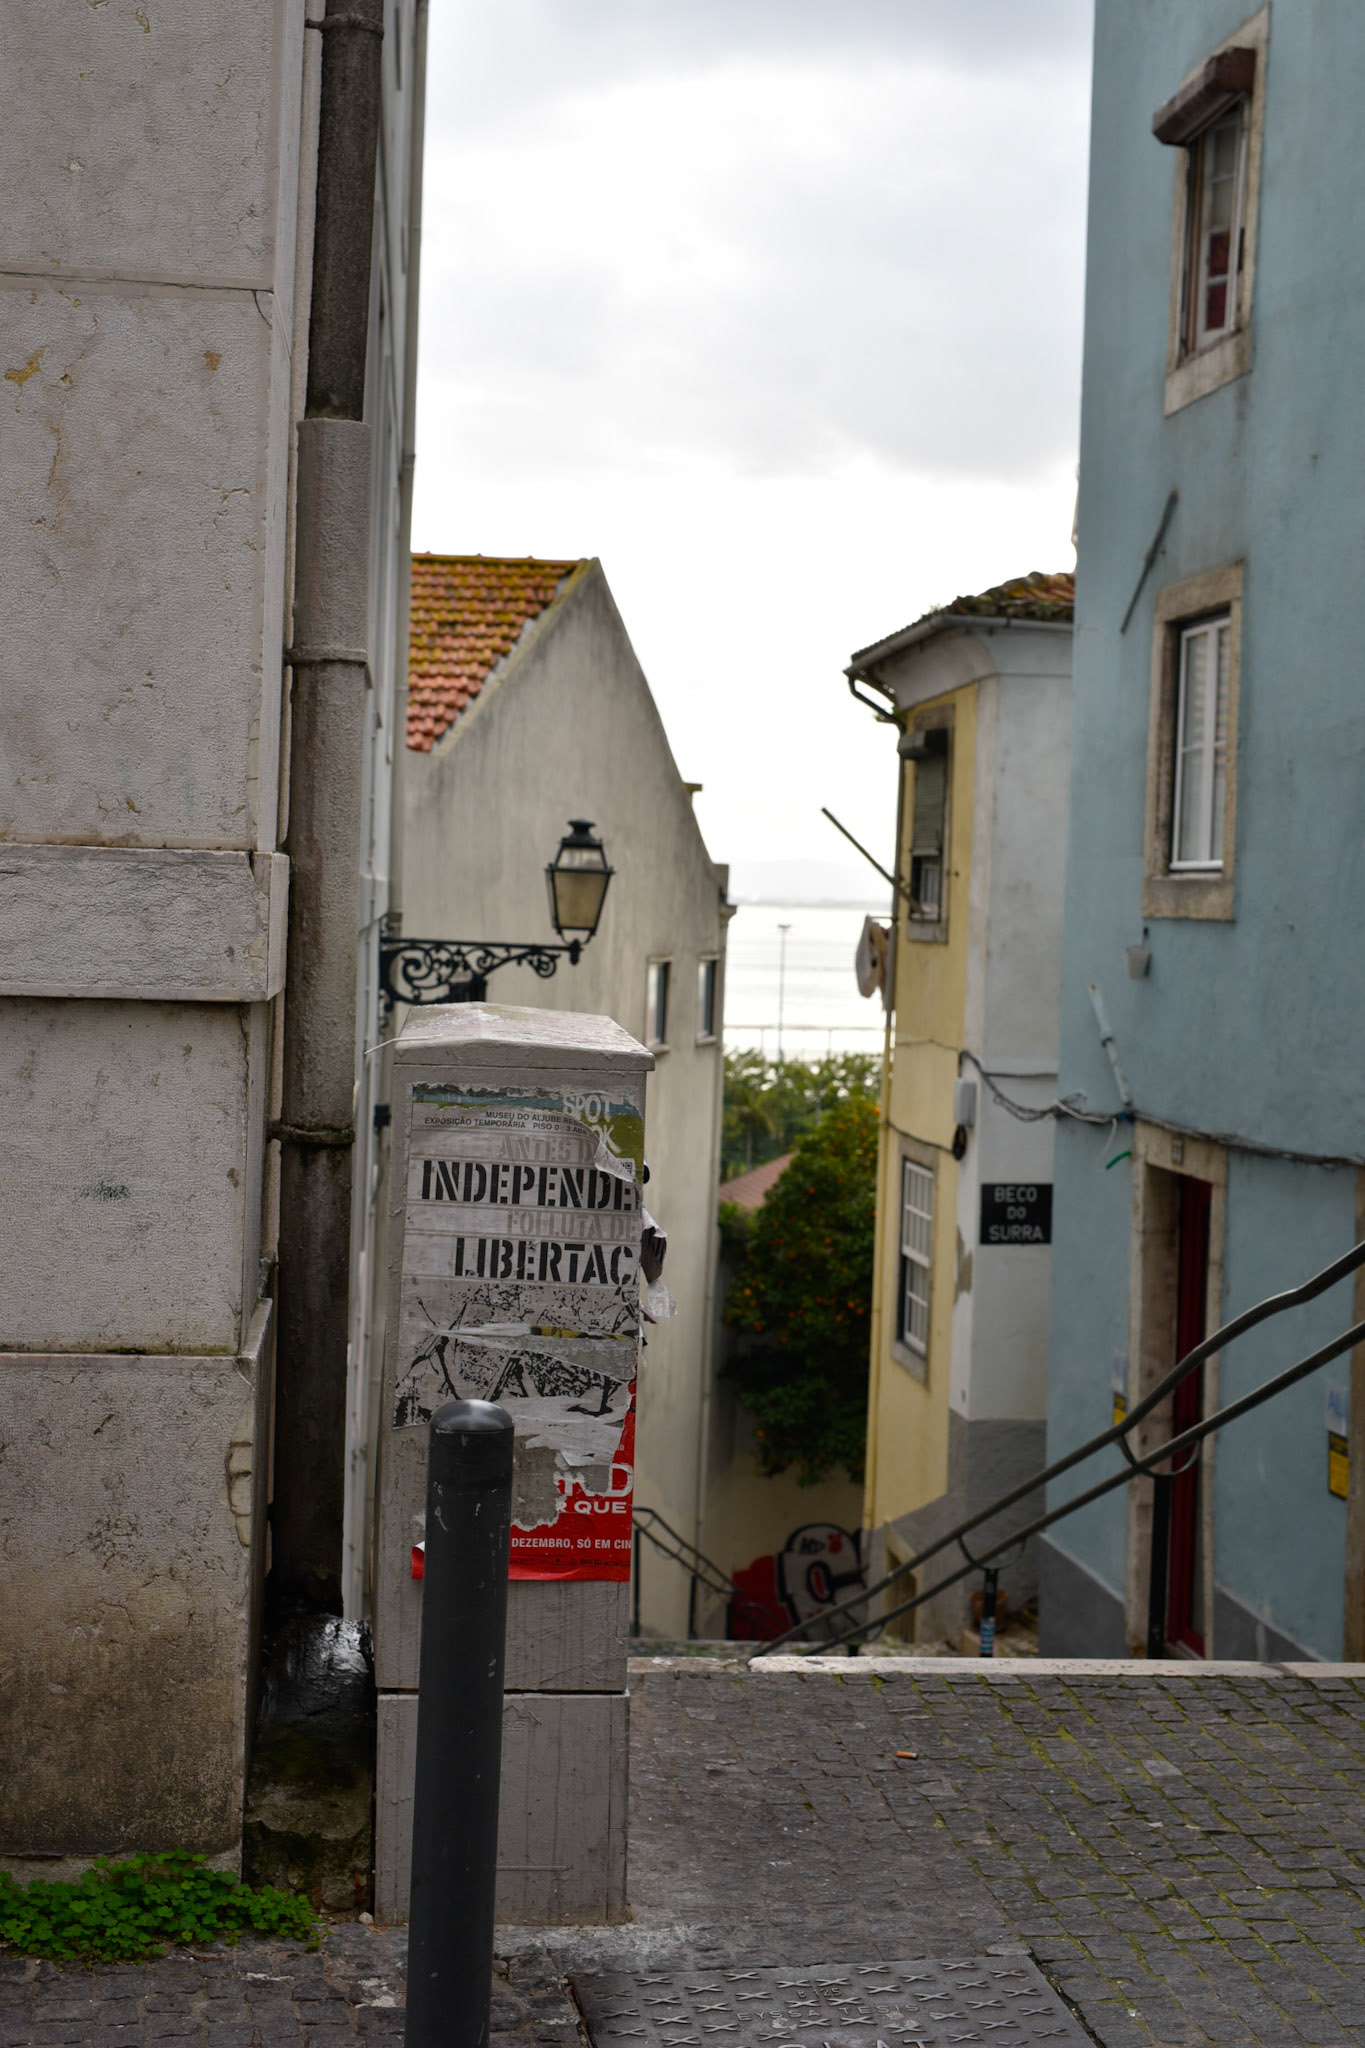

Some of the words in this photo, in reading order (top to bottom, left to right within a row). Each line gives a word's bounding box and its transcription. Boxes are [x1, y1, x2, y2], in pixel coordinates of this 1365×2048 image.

[424, 1116, 472, 1126] EXPOSIÇÃO
[474, 1118, 526, 1128] TEMPORÁRIA
[533, 1122, 552, 1131] PISO
[485, 1111, 515, 1120] MUSEU
[517, 1113, 530, 1121] DO
[532, 1113, 562, 1123] ALJUBE
[497, 1135, 573, 1161] ANTES
[421, 1160, 640, 1211] INDEPENDE
[994, 1186, 1037, 1203] BECO
[1007, 1205, 1027, 1220] DO
[989, 1224, 1044, 1241] SURRA
[454, 1237, 640, 1295] LIBERTAÇ
[574, 1501, 627, 1514] QUE
[511, 1538, 573, 1549] DEZEMBRO,
[576, 1537, 591, 1549] SÓ
[594, 1539, 611, 1549] EM
[813, 1987, 842, 1998] 125
[736, 2009, 822, 2021] EYSSA
[838, 2004, 920, 2015] TESIS
